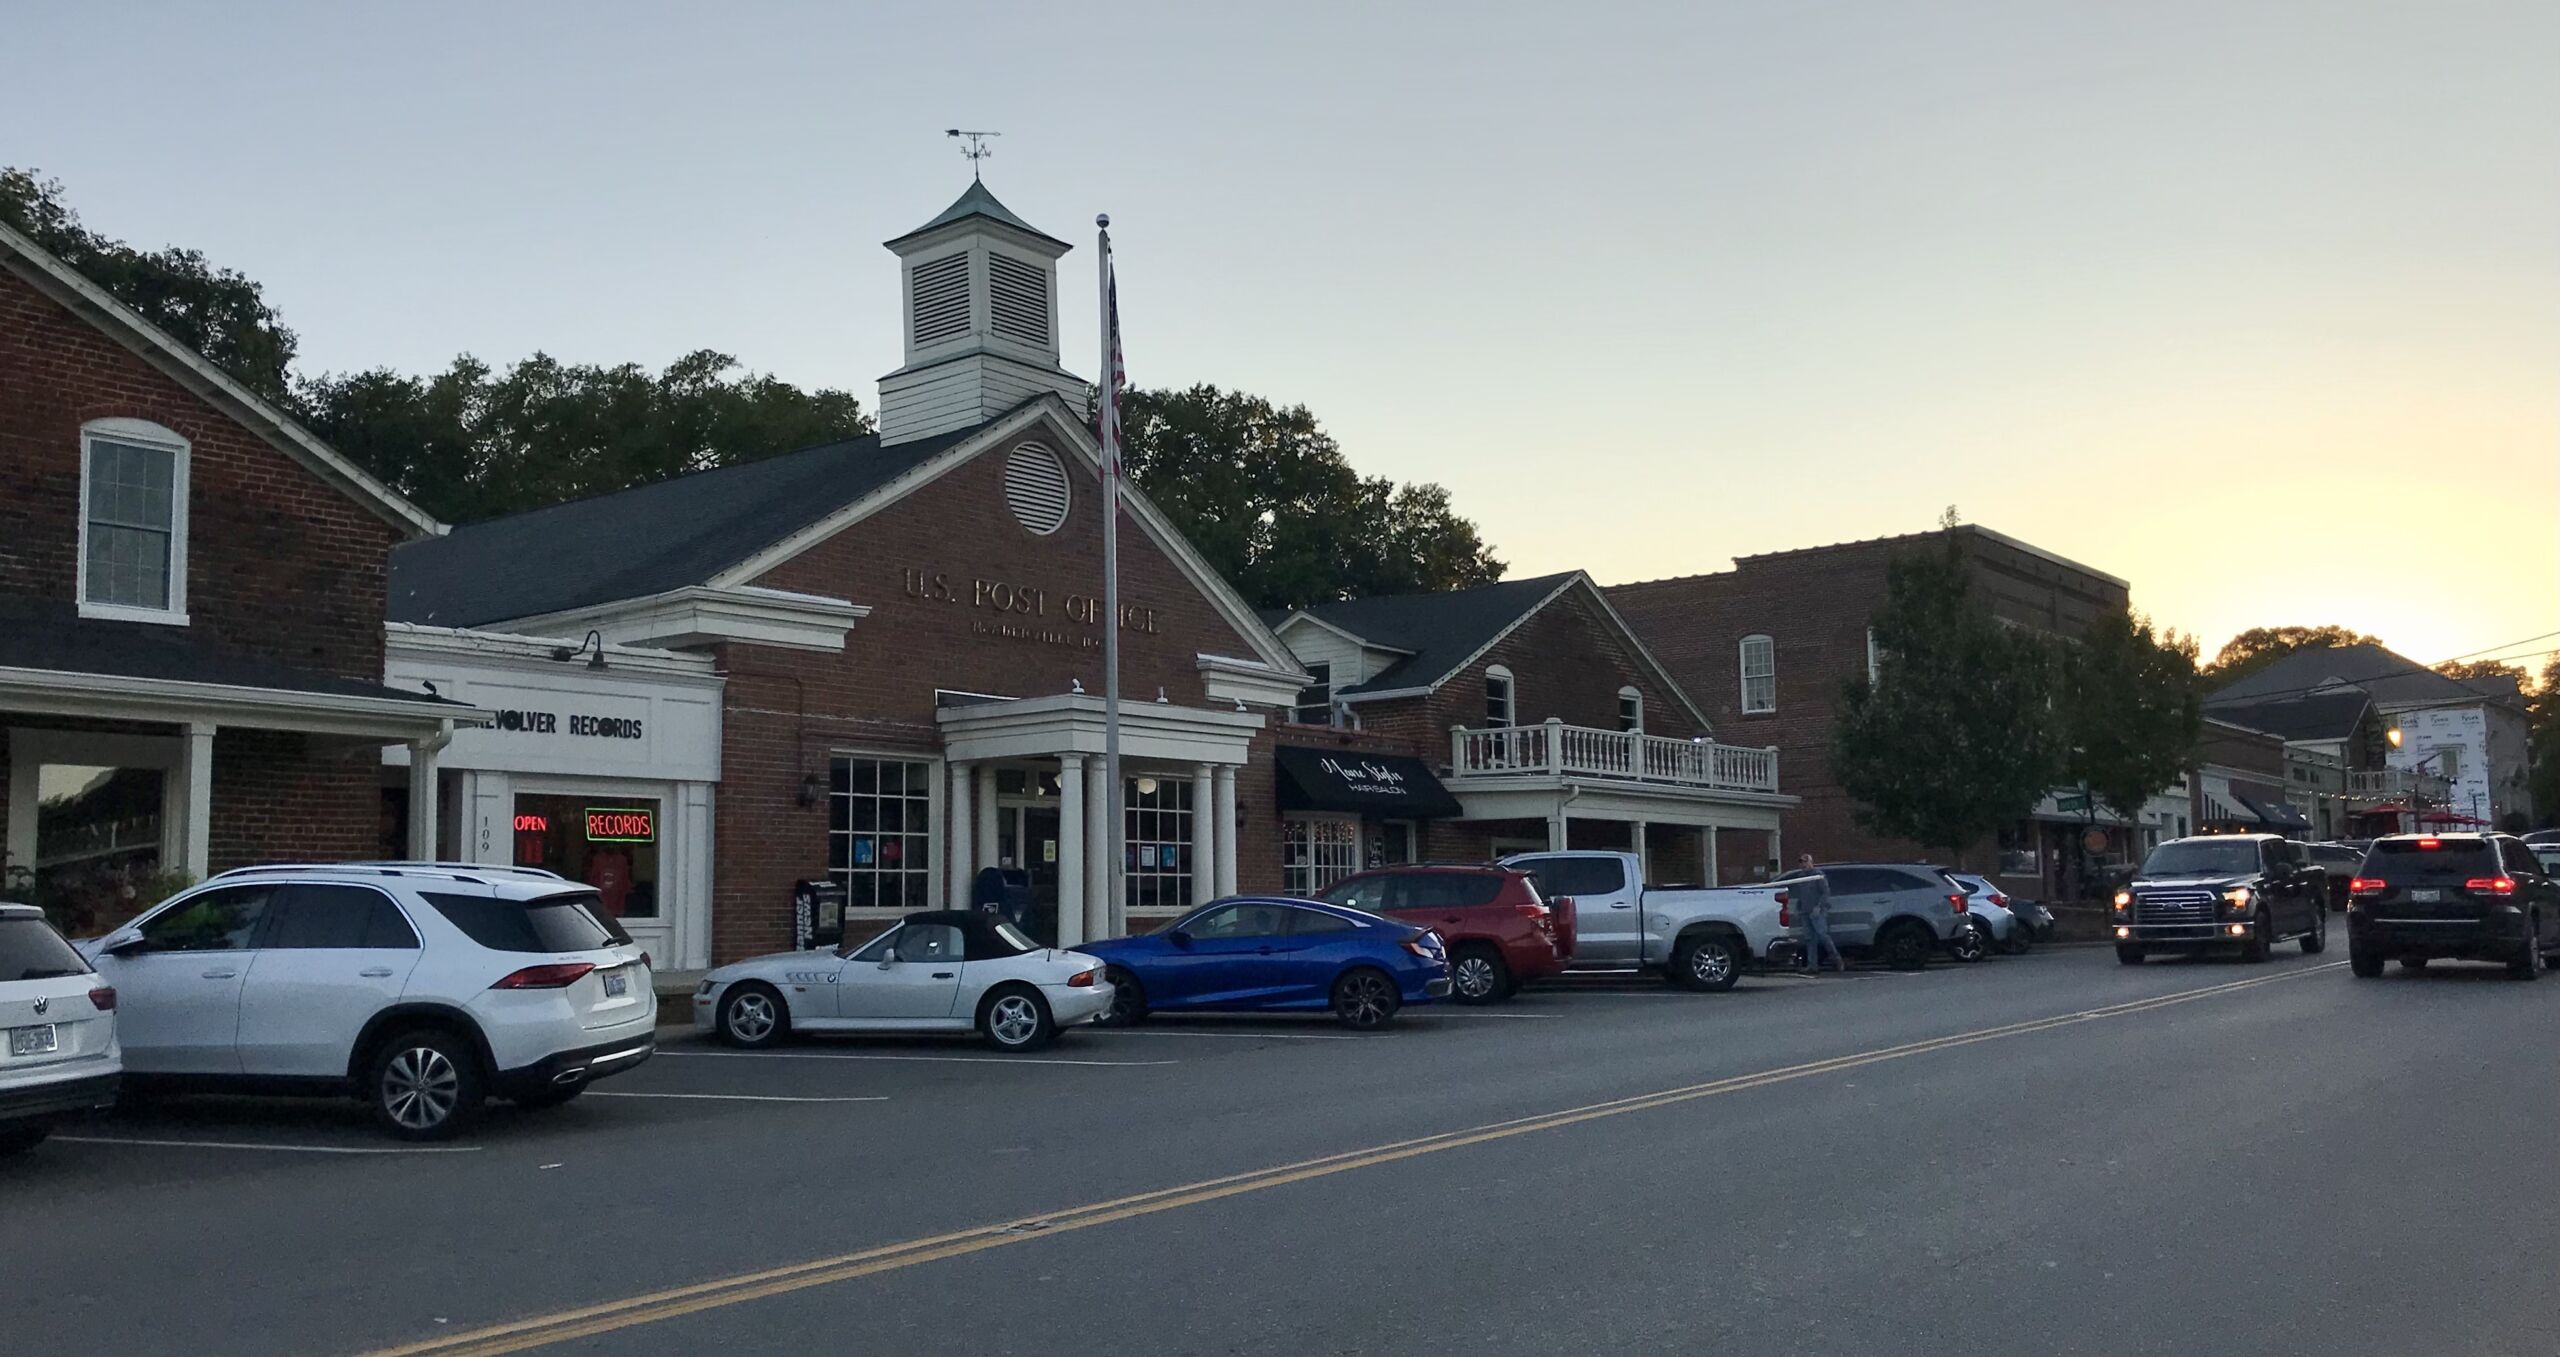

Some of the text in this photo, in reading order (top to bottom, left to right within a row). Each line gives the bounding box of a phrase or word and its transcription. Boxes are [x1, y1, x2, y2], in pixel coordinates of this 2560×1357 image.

[904, 569, 1161, 634] U.S. POST OFICE
[570, 714, 642, 739] RECORDS
[514, 815, 547, 832] OPEN
[588, 814, 651, 836] RECORDS
